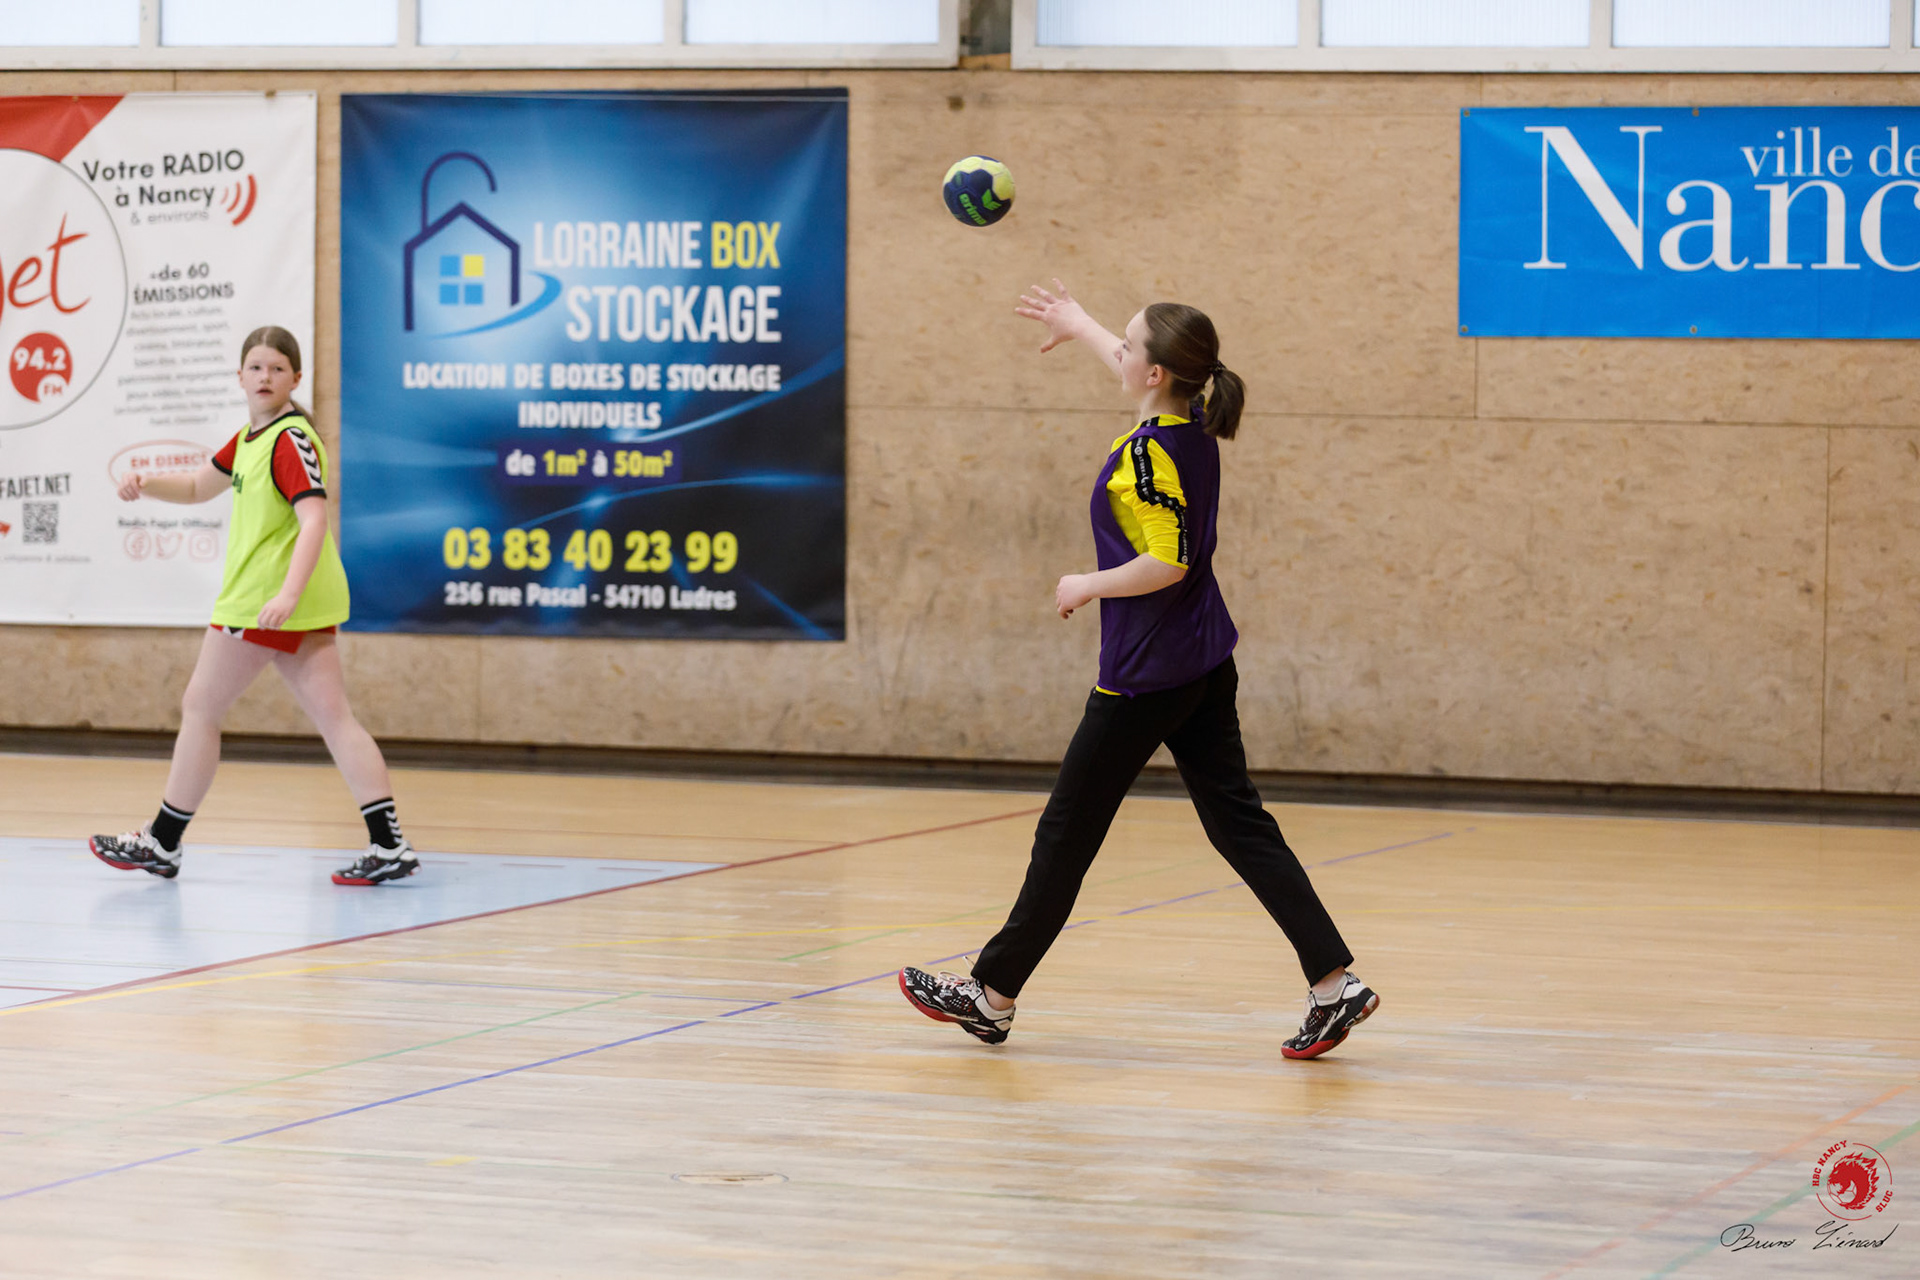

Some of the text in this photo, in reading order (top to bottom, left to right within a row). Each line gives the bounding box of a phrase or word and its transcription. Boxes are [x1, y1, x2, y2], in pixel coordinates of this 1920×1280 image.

[83, 149, 244, 182] Votre RADIO
[1740, 126, 1920, 177] ville de
[115, 184, 215, 208] à Nancy
[147, 208, 210, 224] environs
[534, 221, 782, 269] LORRAINE BOX
[188, 261, 210, 279] 60
[565, 285, 782, 343] STOCKAGE
[13, 346, 67, 371] 94.2
[43, 383, 63, 396] FM
[403, 363, 781, 392] LOCATION DE BOXES DE STOCKAGE
[518, 402, 662, 429] INDIVIDUELS
[130, 451, 207, 469] EN DIRECT
[505, 448, 536, 476] de
[591, 449, 608, 478] à
[443, 527, 738, 574] 03 83 40 23 99
[444, 581, 484, 606] 256
[487, 586, 522, 607] rue
[526, 583, 587, 608] Pascal
[604, 585, 665, 609] 54710
[669, 586, 737, 611] Ludres
